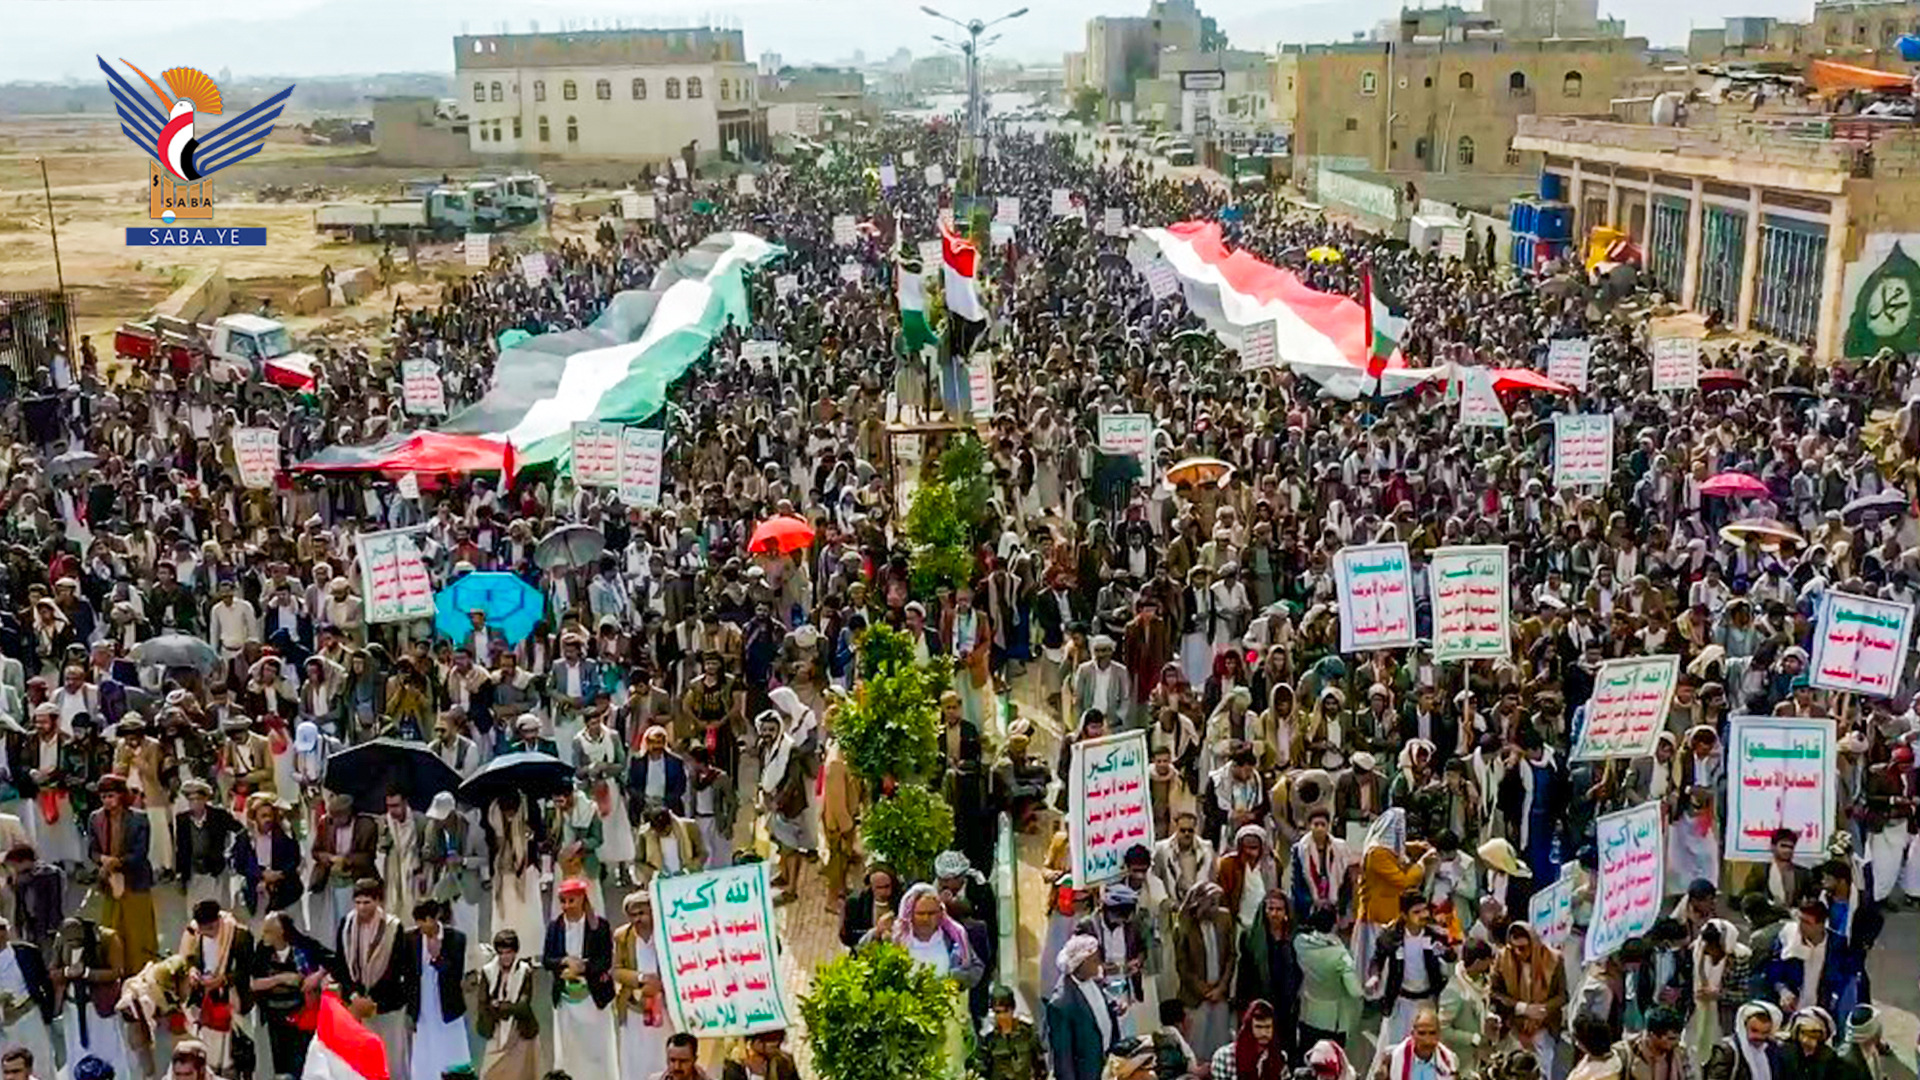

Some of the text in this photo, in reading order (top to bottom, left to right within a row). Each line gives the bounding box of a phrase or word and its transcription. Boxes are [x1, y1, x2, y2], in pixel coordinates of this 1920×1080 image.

[1121, 746, 1141, 768] الله
[1743, 738, 1821, 762] قاطعوا
[725, 876, 759, 904] الله
[725, 912, 762, 937] الموت
[730, 941, 766, 966] الموت
[744, 997, 782, 1029] النصر
